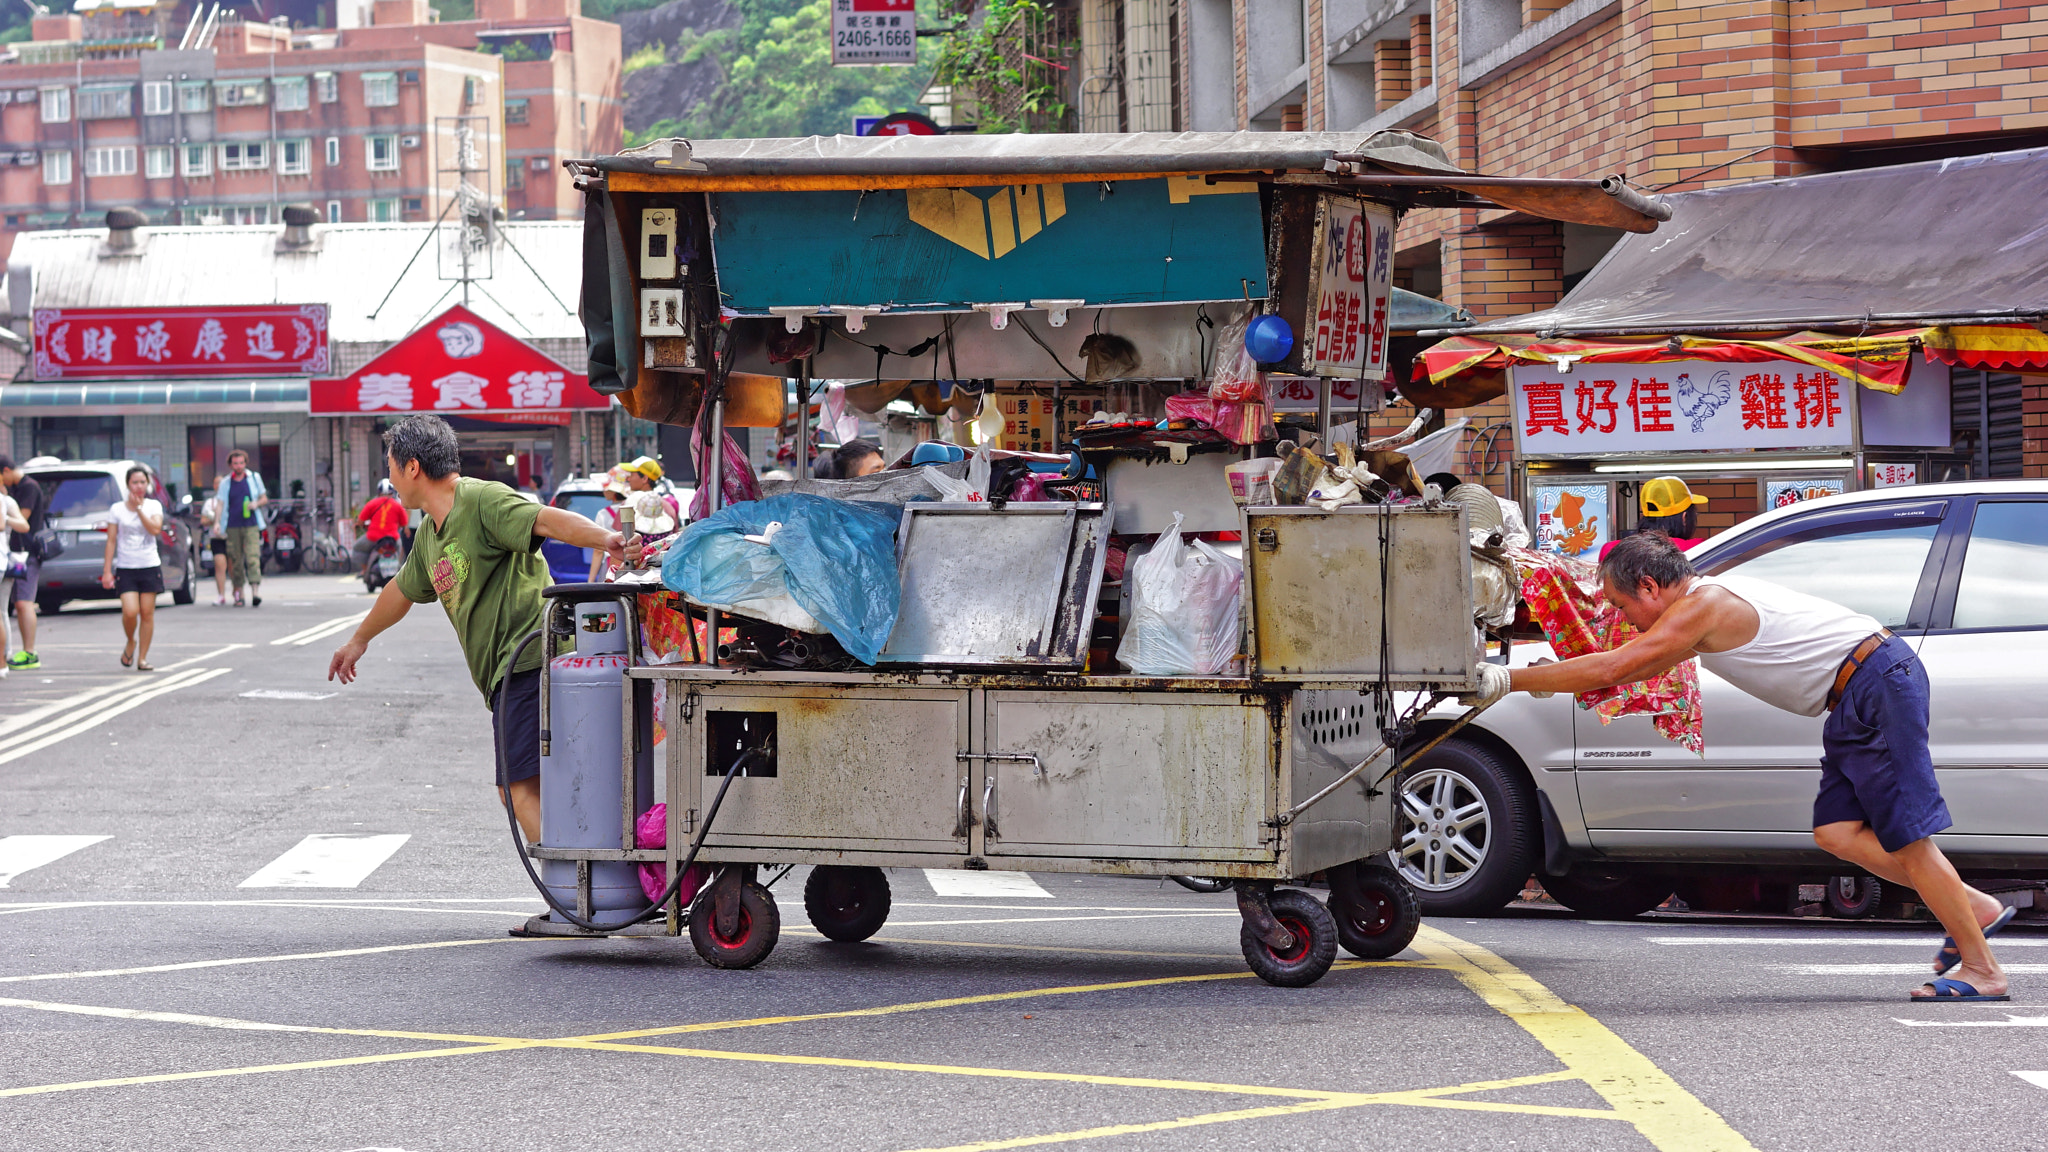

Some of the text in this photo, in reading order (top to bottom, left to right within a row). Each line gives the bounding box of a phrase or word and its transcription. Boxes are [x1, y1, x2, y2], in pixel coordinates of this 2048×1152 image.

[838, 30, 912, 47] 2406-1666
[846, 15, 901, 28] 報名專線
[81, 318, 285, 363] 財源廣進
[1316, 289, 1386, 364] 台灣第一香
[358, 371, 566, 411] 美食街
[1523, 371, 1842, 437] 真好佳 雞排
[1886, 465, 1906, 484] 調味
